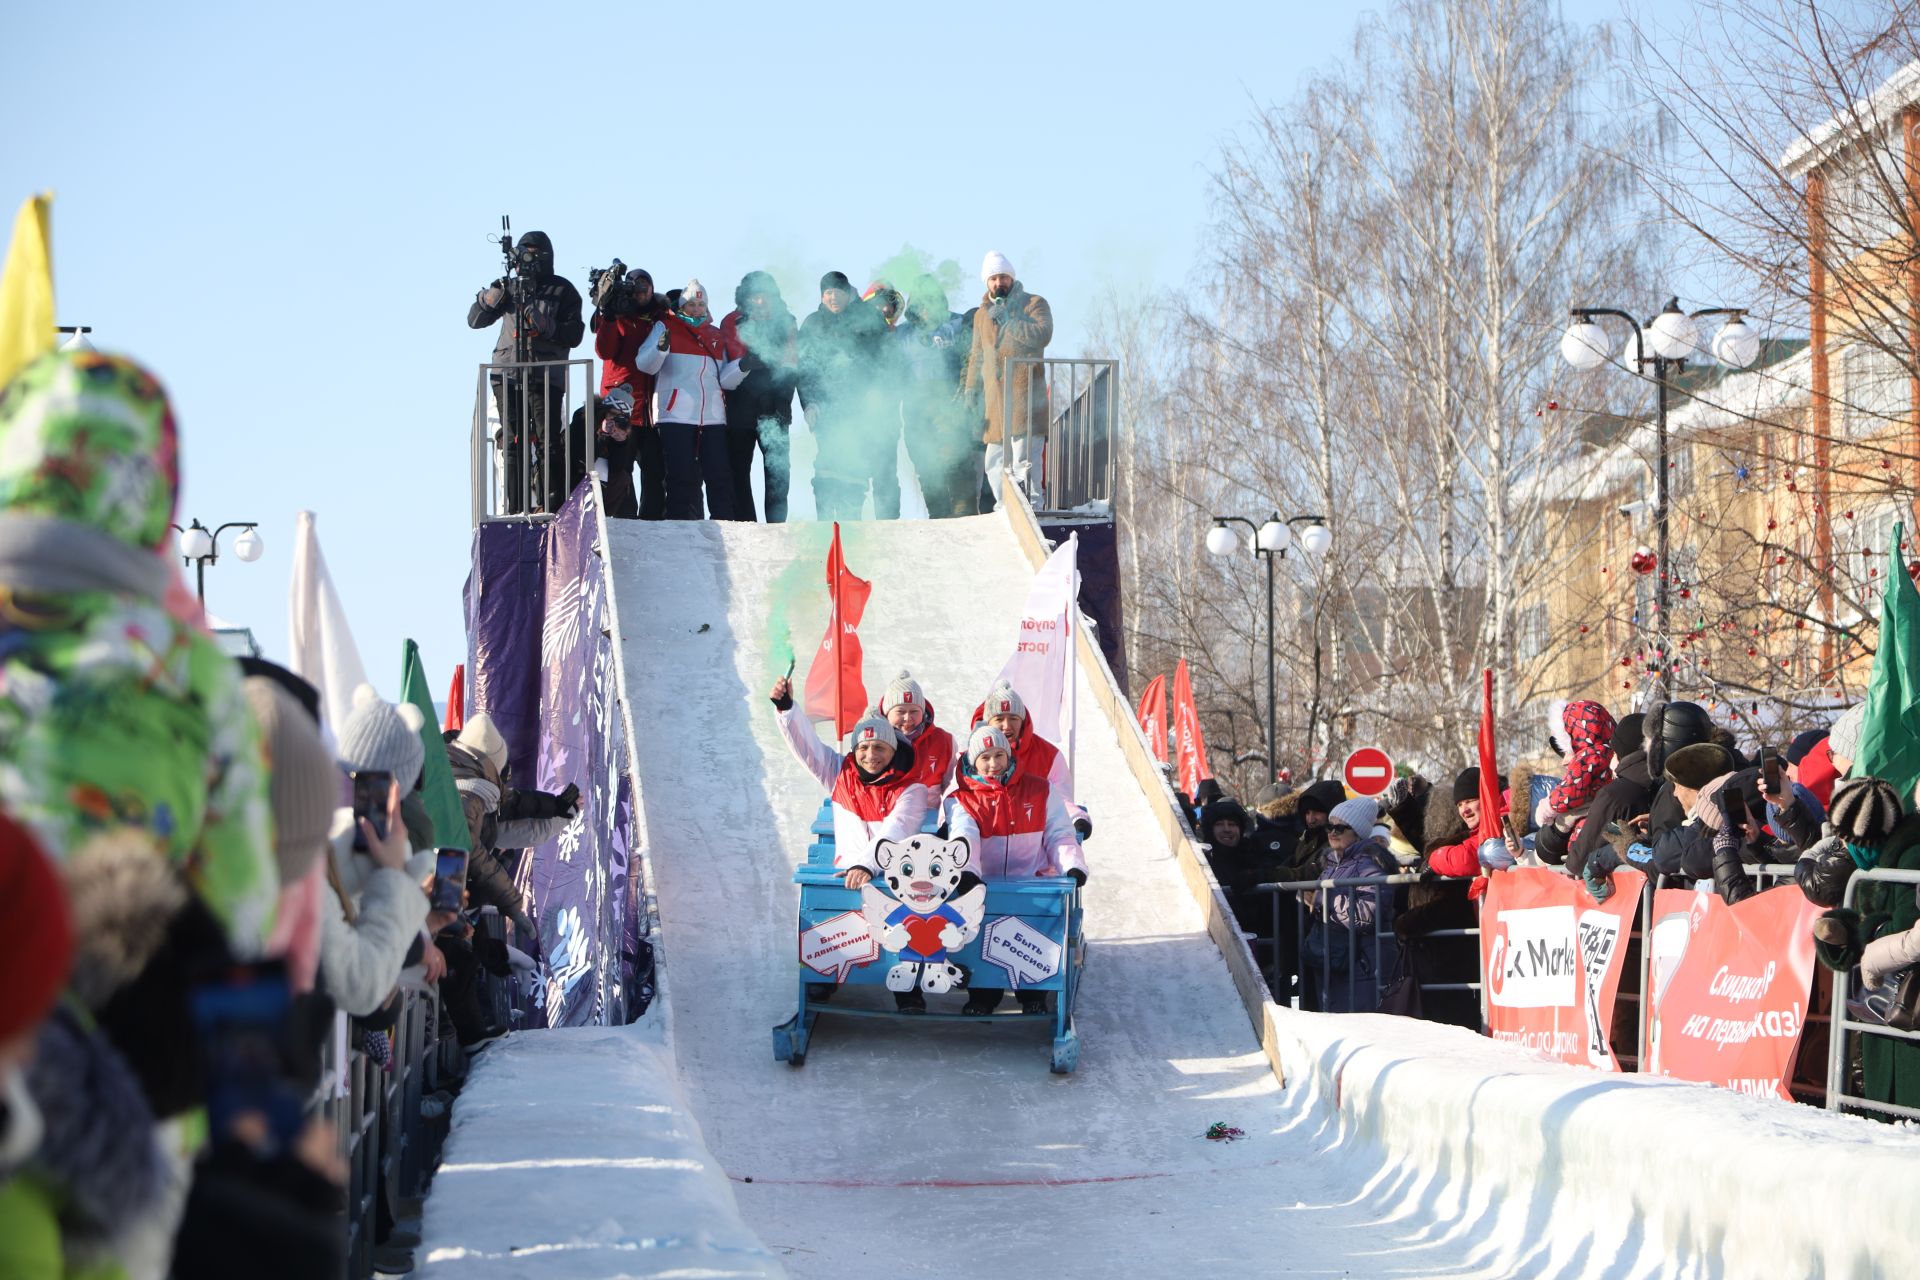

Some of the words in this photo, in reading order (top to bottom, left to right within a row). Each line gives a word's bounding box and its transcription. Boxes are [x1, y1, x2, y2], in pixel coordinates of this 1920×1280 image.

[813, 932, 871, 959] движении
[819, 928, 848, 945] Быть
[1013, 931, 1043, 956] Быть
[1002, 939, 1051, 974] Россией
[1681, 1014, 1711, 1038] на
